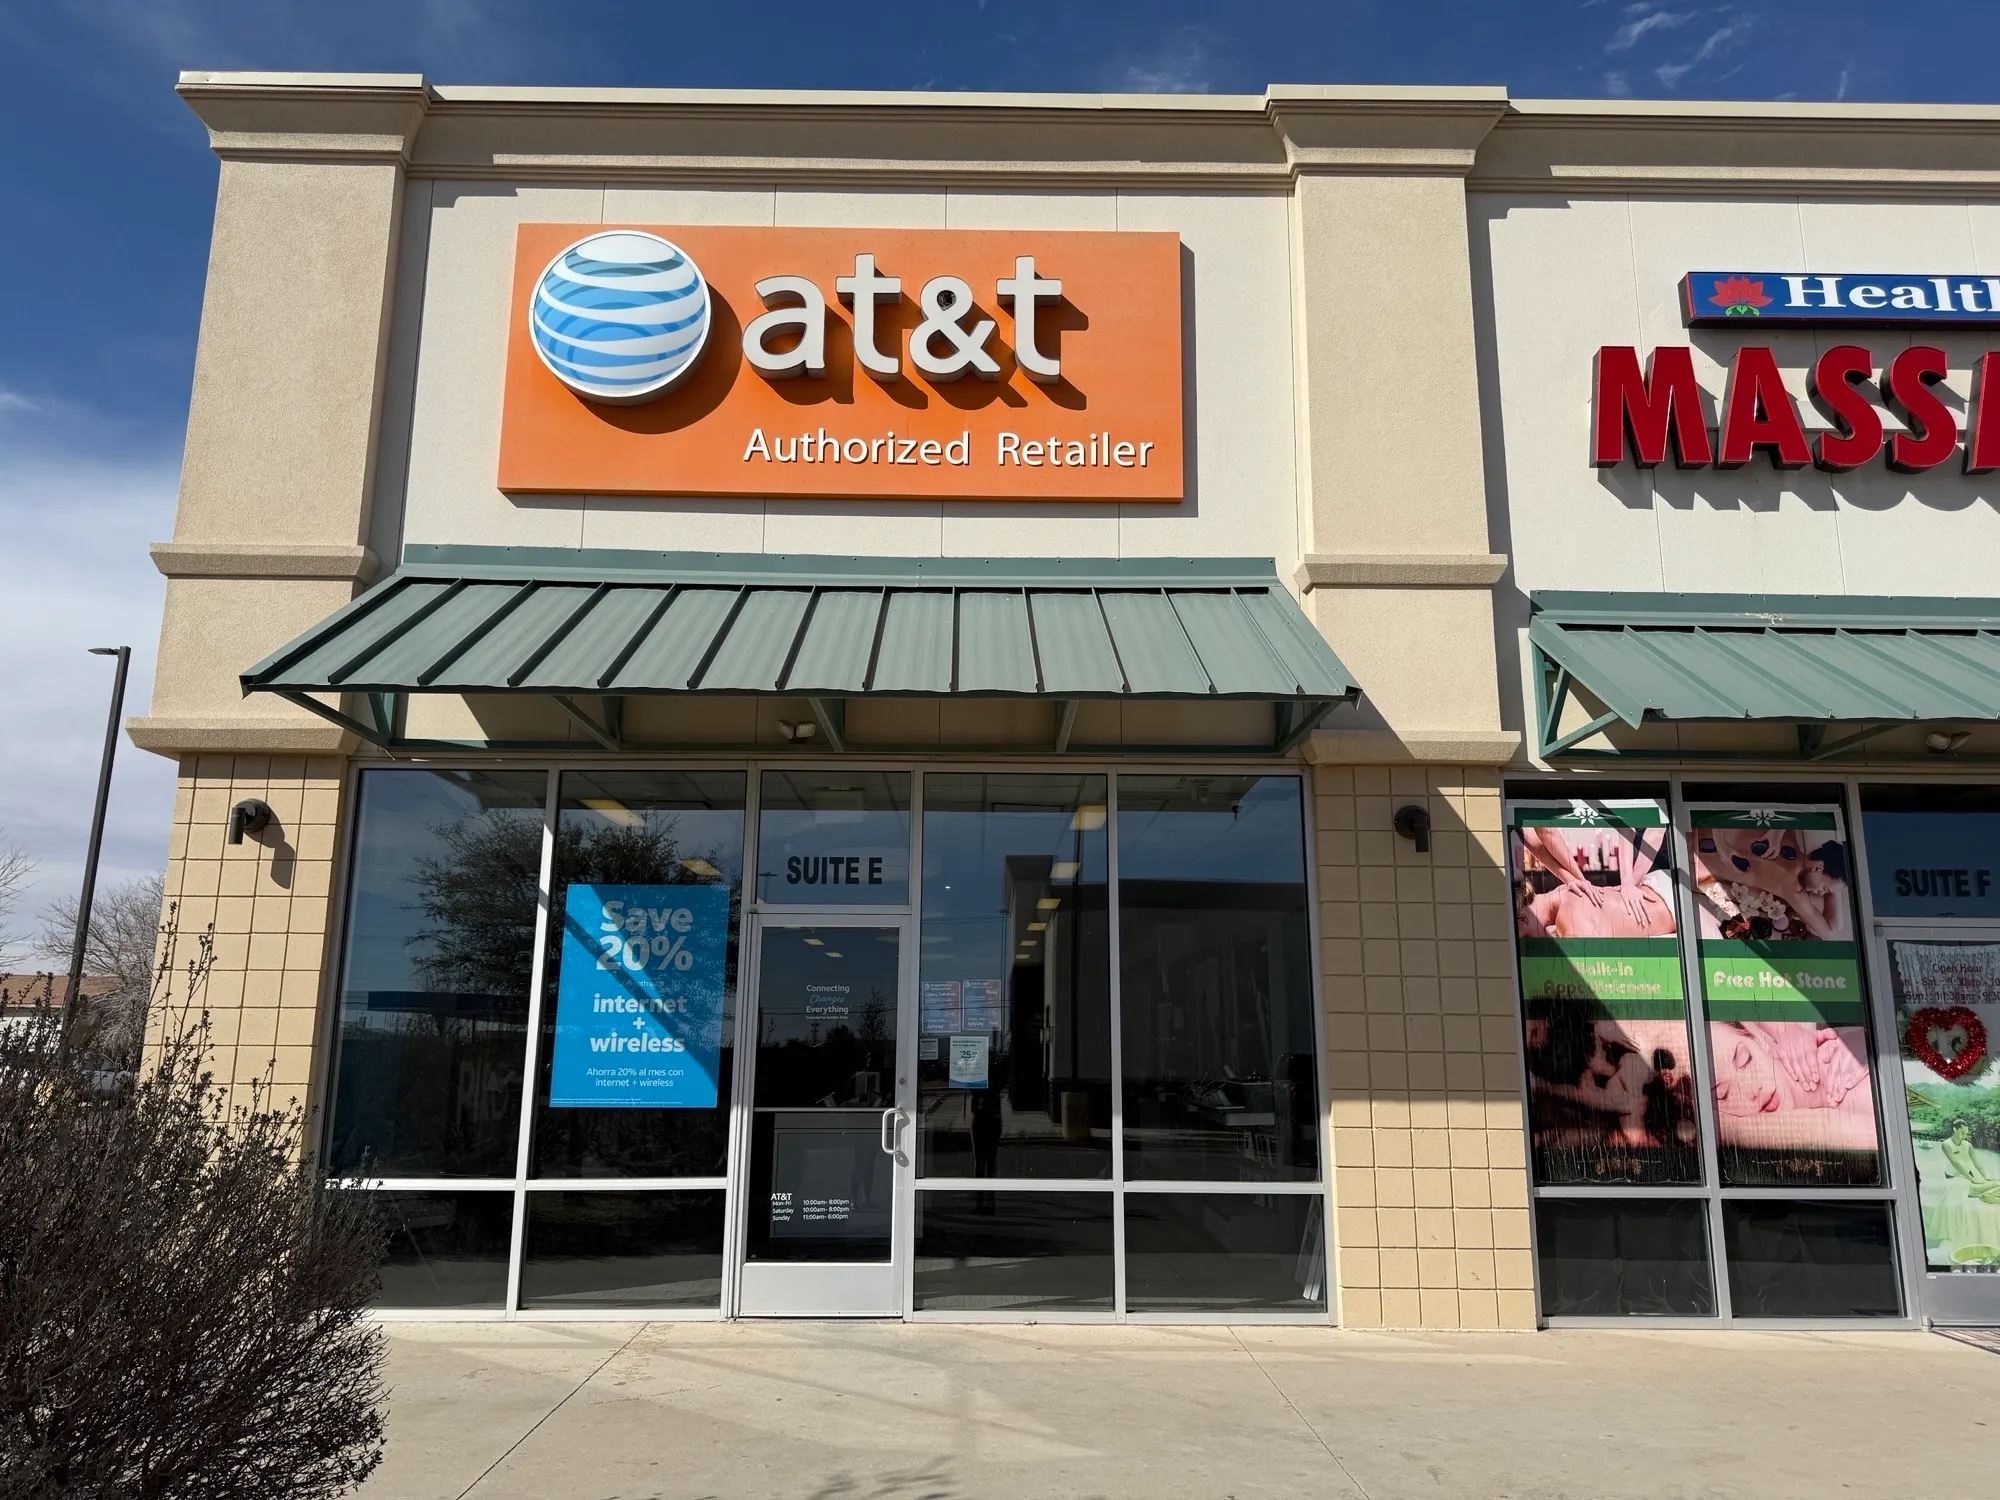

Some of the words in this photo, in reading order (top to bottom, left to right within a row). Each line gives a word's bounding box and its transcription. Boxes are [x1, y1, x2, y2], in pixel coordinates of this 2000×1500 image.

[742, 253, 1062, 381] at&t
[742, 427, 970, 466] Authorized
[997, 431, 1155, 468] Retailer
[786, 855, 860, 885] SUITE
[868, 856, 883, 885] E
[1894, 868, 1972, 897] SUITE
[1976, 869, 1991, 897] F
[600, 900, 694, 933] Save
[596, 935, 694, 971] 20%
[1932, 963, 1958, 974] Open
[1960, 963, 1983, 973] Hour
[1587, 979, 1661, 995] Welcome
[1713, 970, 1755, 988] Free
[1758, 971, 1793, 988] Hot
[1796, 971, 1847, 989] Stone
[806, 984, 850, 993] Connecting
[593, 993, 688, 1014] internet
[810, 994, 845, 1005] Changes
[806, 1005, 849, 1015] Everything
[632, 1016, 646, 1030] +
[589, 1032, 686, 1053] wireless
[586, 1067, 616, 1076] Ahorra
[617, 1067, 637, 1076] 20%
[638, 1067, 647, 1076] al
[595, 1078, 630, 1087] internet
[639, 1078, 674, 1087] wireless
[828, 1199, 850, 1207] 8:00pm
[828, 1206, 850, 1214] 8:00pm
[827, 1213, 849, 1221] 6:00pm
